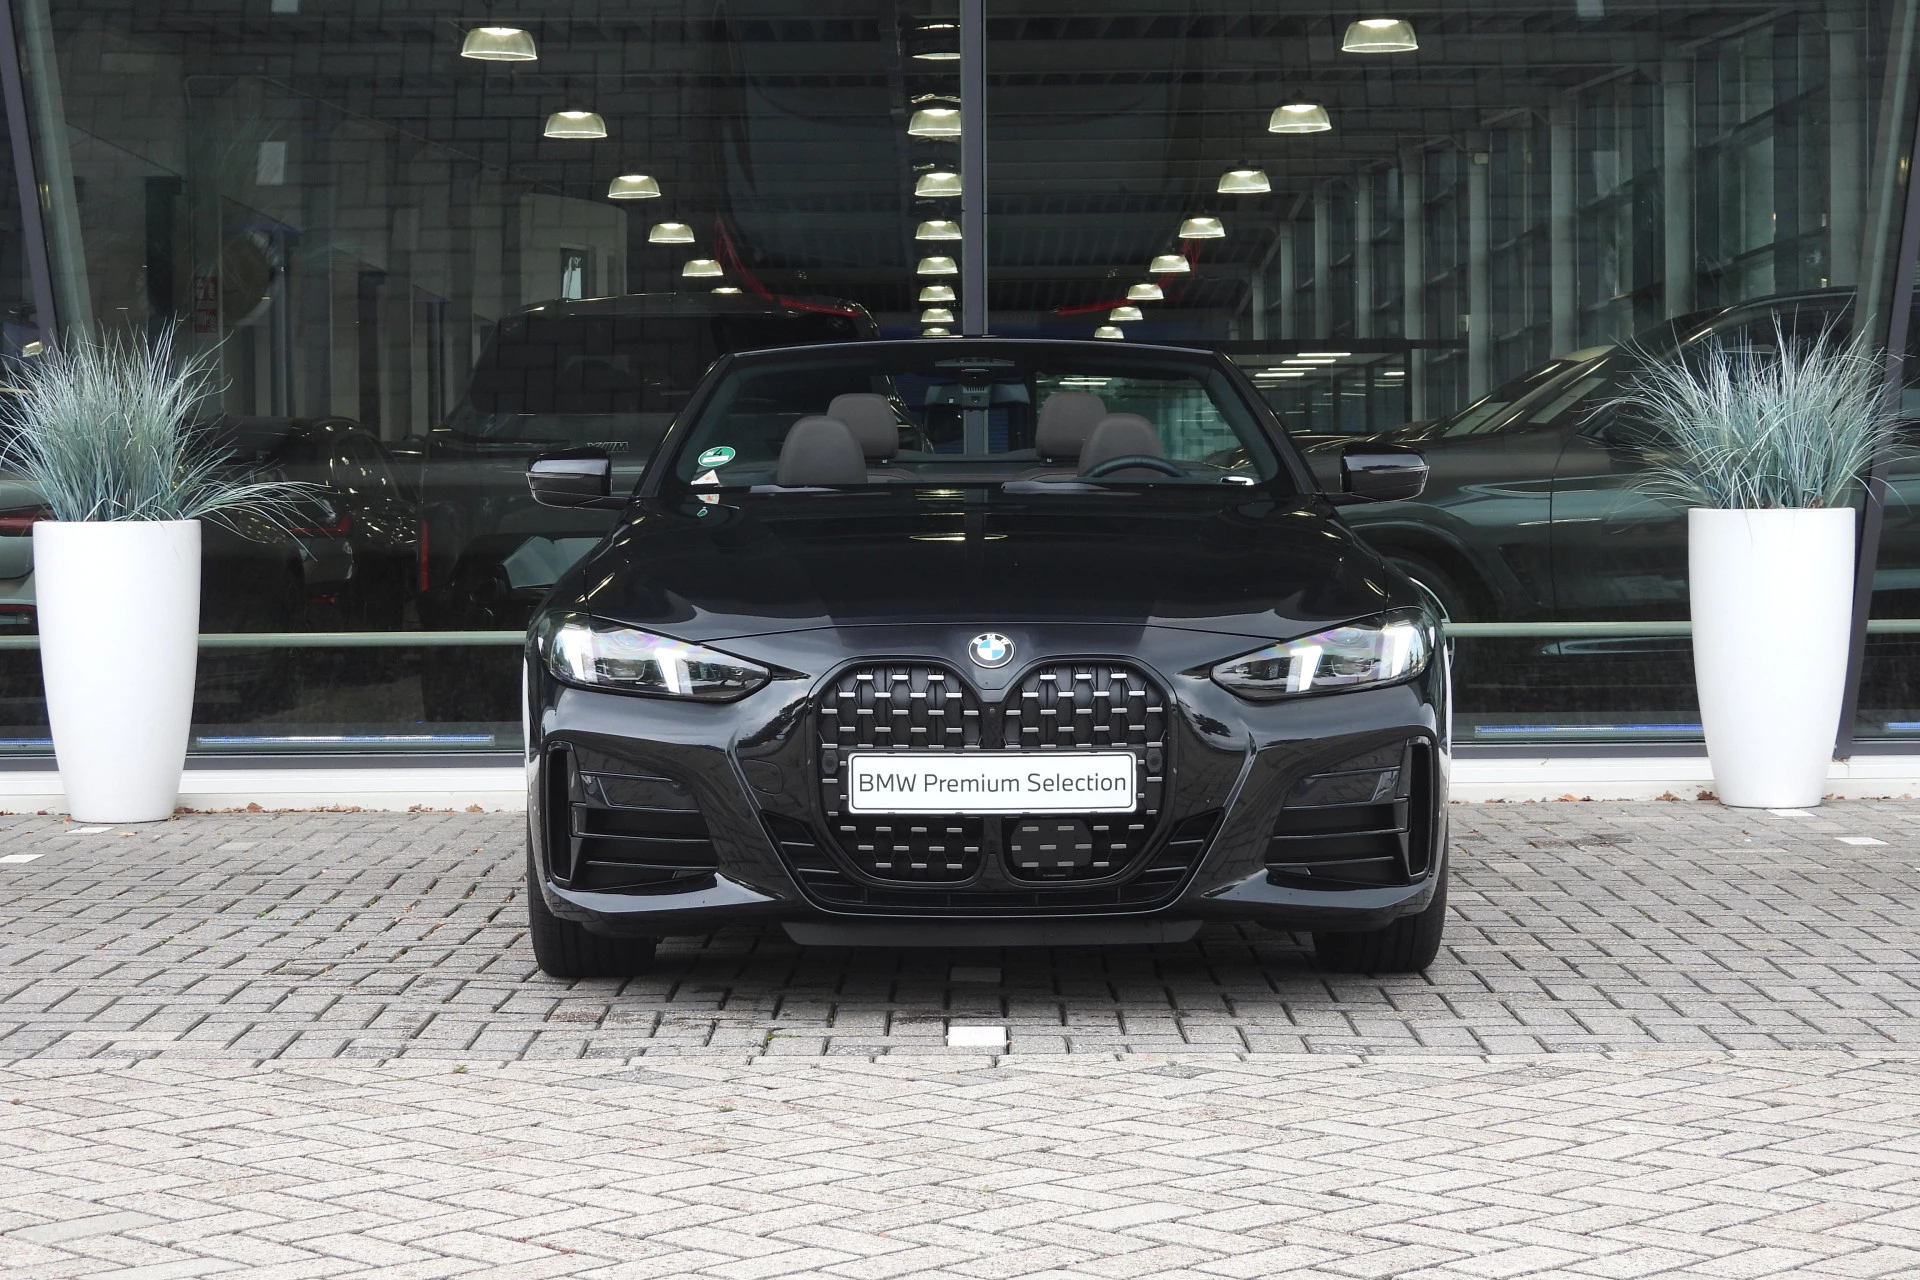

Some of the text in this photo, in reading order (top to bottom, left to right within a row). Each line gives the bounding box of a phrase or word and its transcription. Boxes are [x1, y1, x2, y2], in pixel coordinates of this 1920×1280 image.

[713, 447, 723, 456] 4
[859, 772, 1126, 792] BMW Premium Selection
